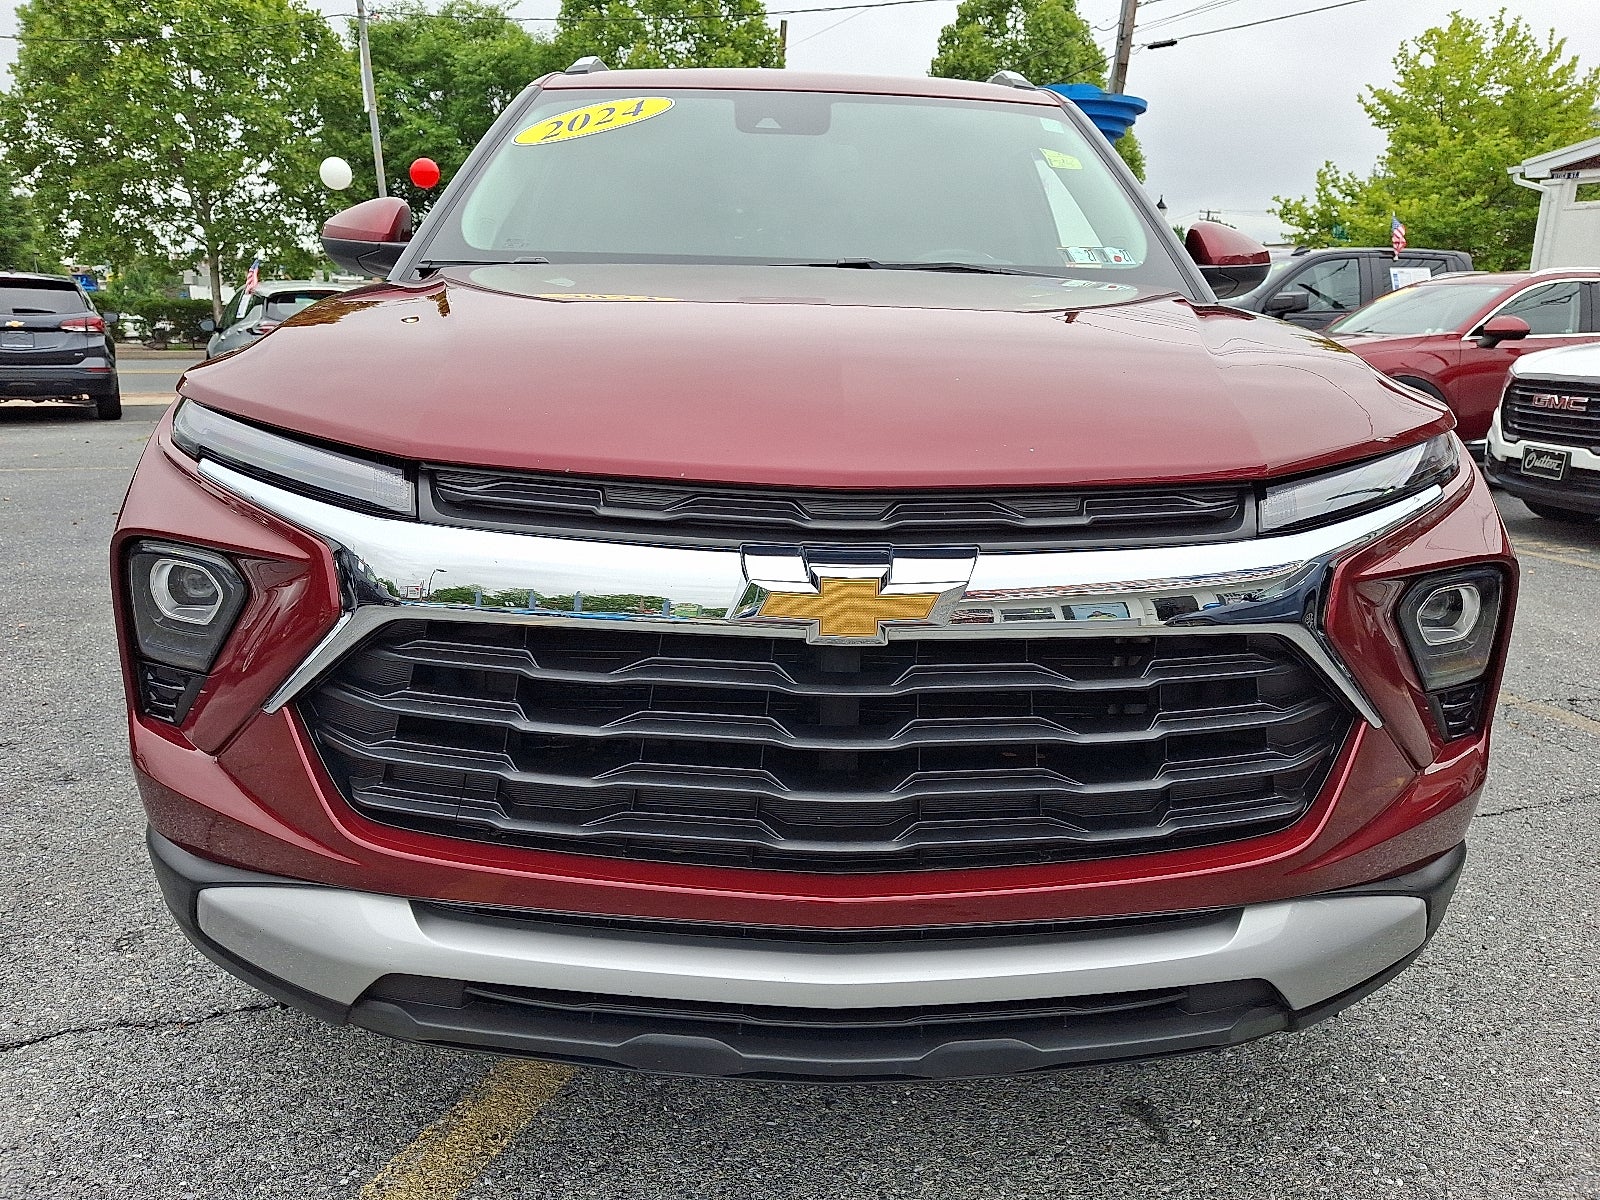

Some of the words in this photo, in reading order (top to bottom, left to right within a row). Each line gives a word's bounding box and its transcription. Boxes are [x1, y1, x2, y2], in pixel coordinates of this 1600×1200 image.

[540, 99, 645, 141] 2024
[1532, 393, 1590, 412] GMC
[1524, 451, 1563, 471] Outten
